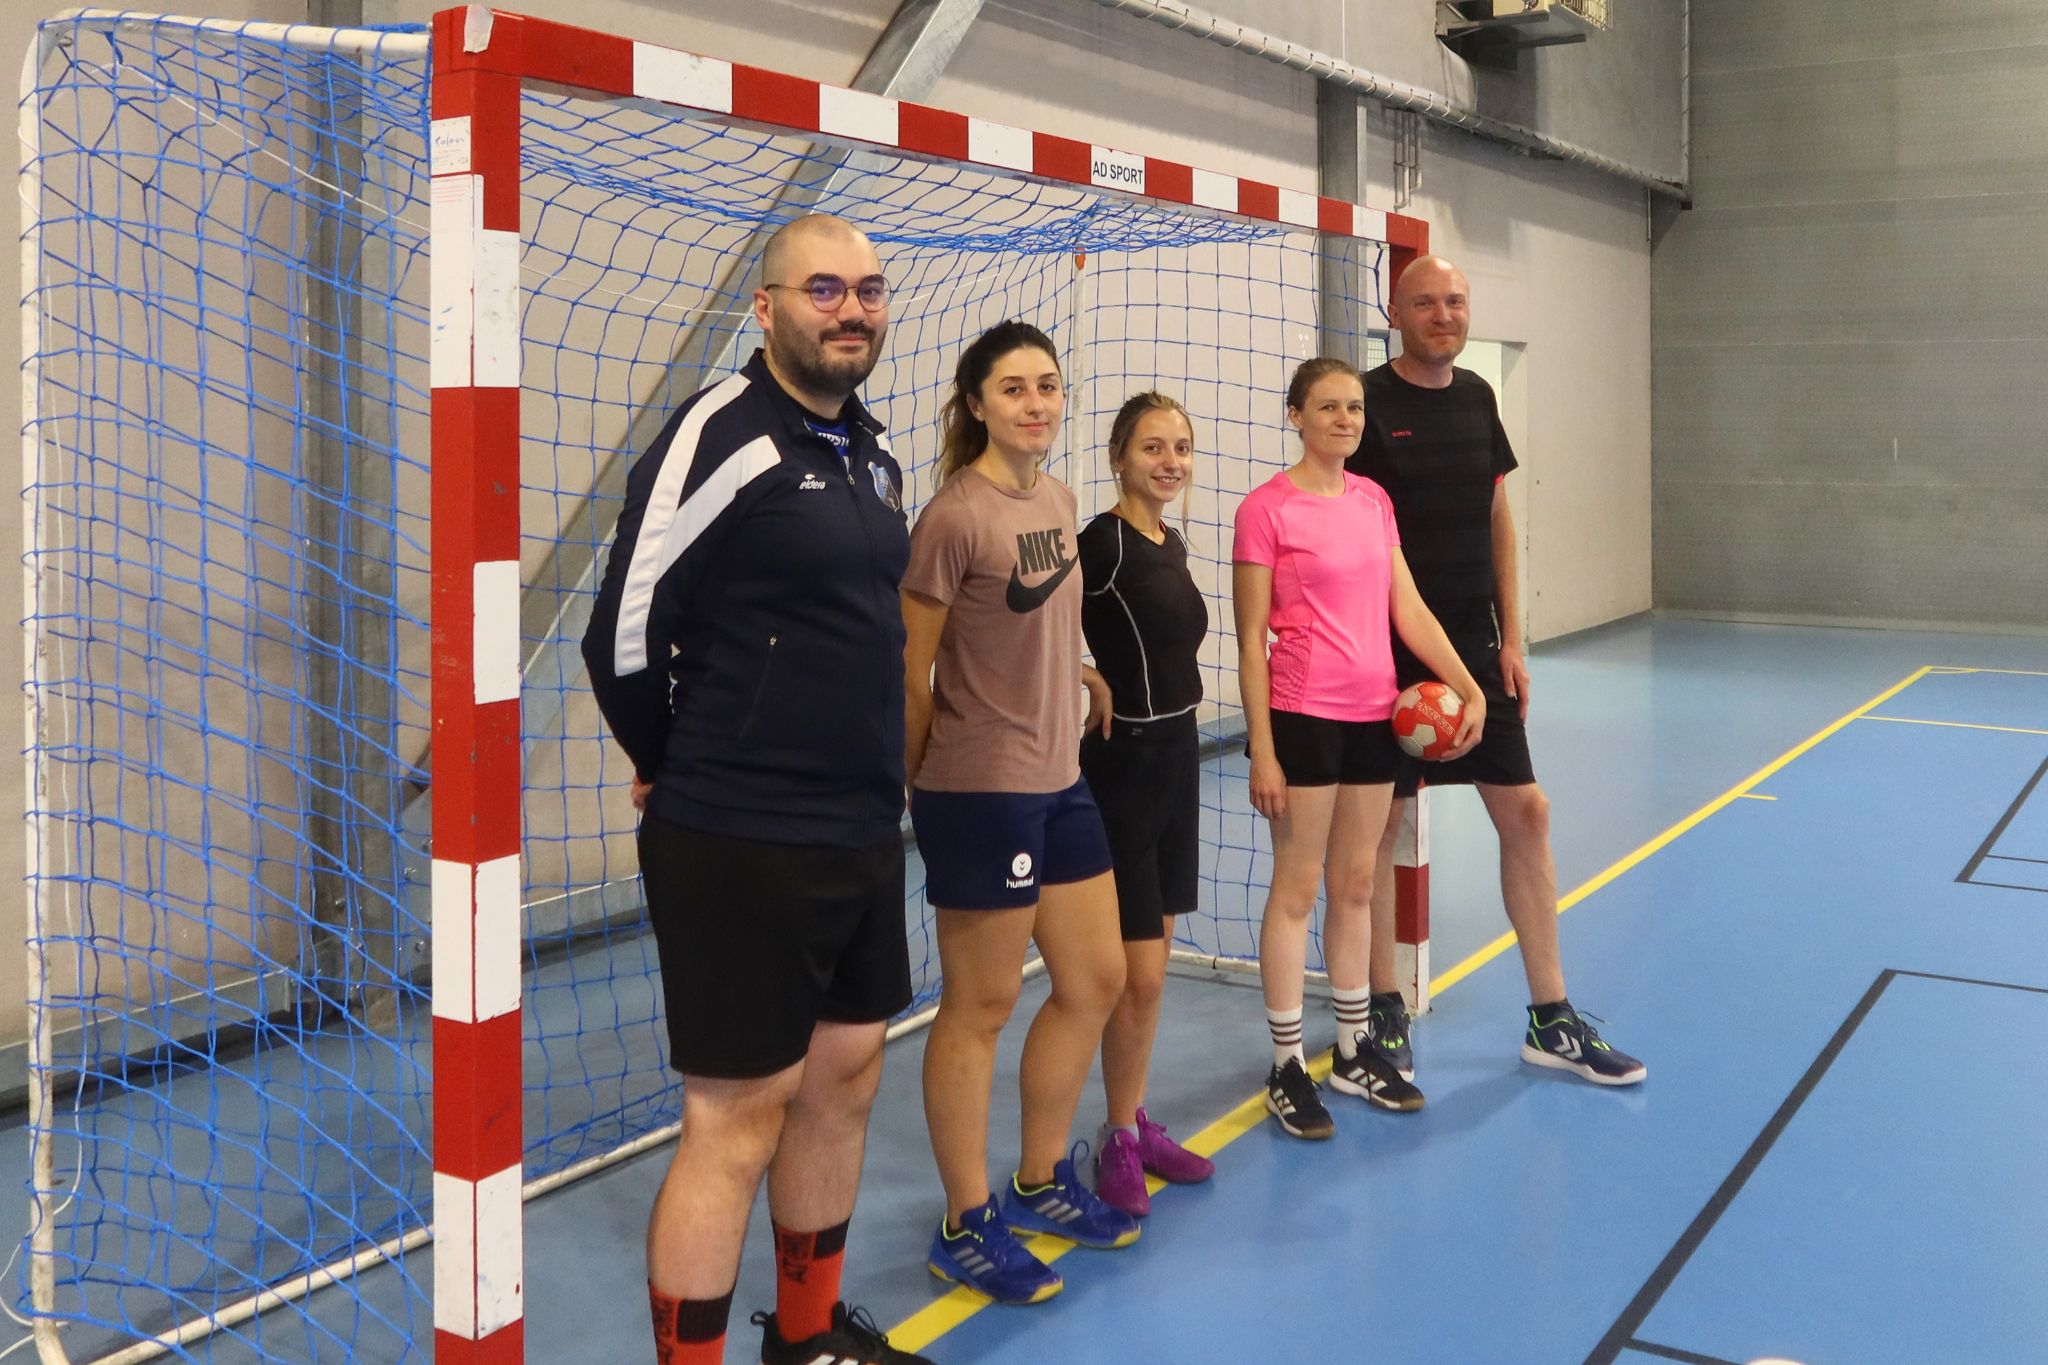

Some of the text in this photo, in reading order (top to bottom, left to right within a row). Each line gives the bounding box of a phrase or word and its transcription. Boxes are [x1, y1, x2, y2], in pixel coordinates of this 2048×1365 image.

[1093, 161, 1143, 184] AD SPORT
[1016, 528, 1072, 576] NIKE
